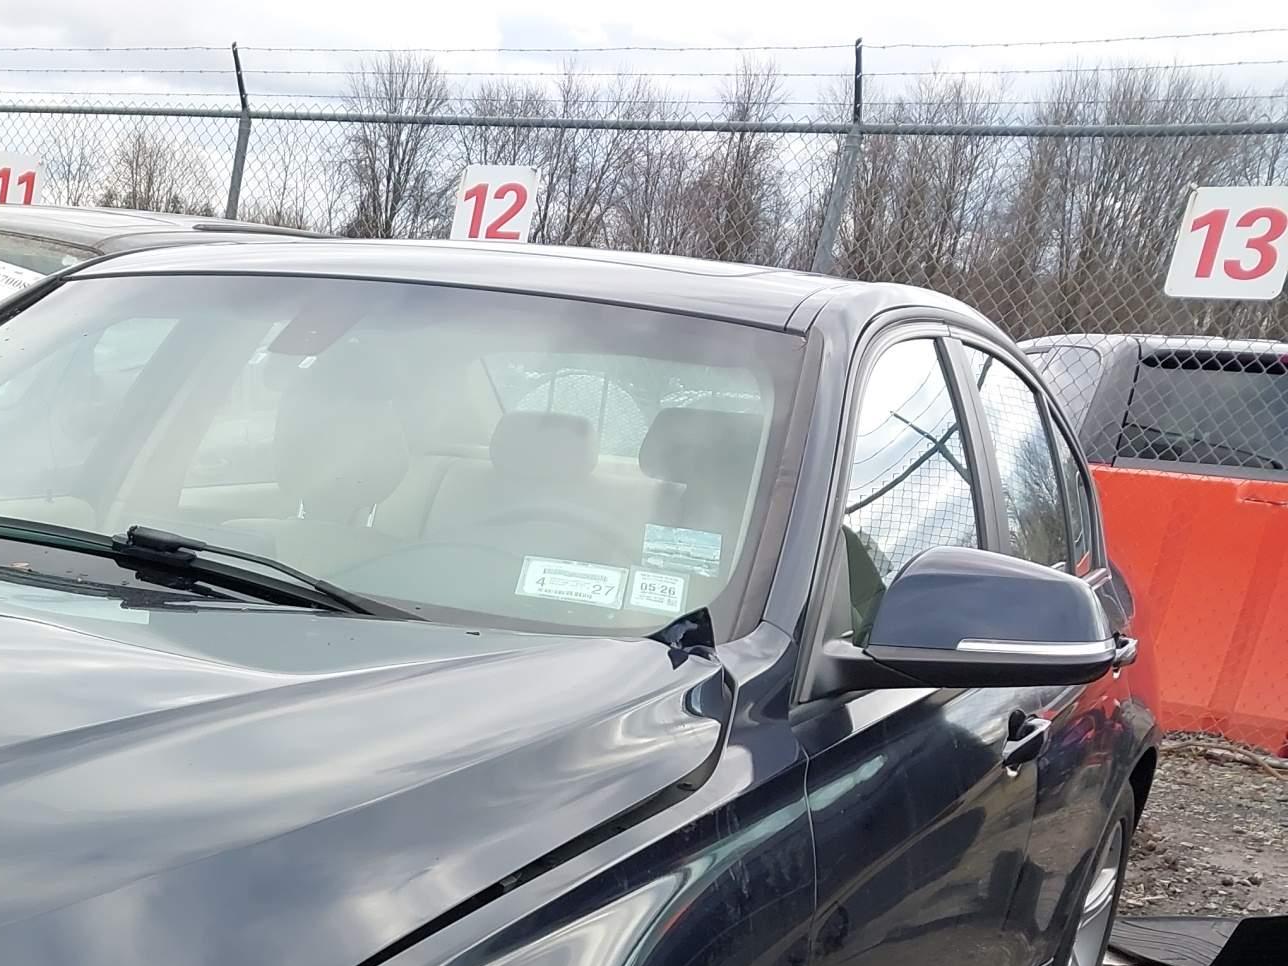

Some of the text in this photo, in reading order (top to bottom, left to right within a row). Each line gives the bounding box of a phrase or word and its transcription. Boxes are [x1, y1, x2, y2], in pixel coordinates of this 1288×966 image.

[463, 183, 528, 240] 12
[1190, 207, 1288, 281] 13
[590, 584, 616, 597] 27
